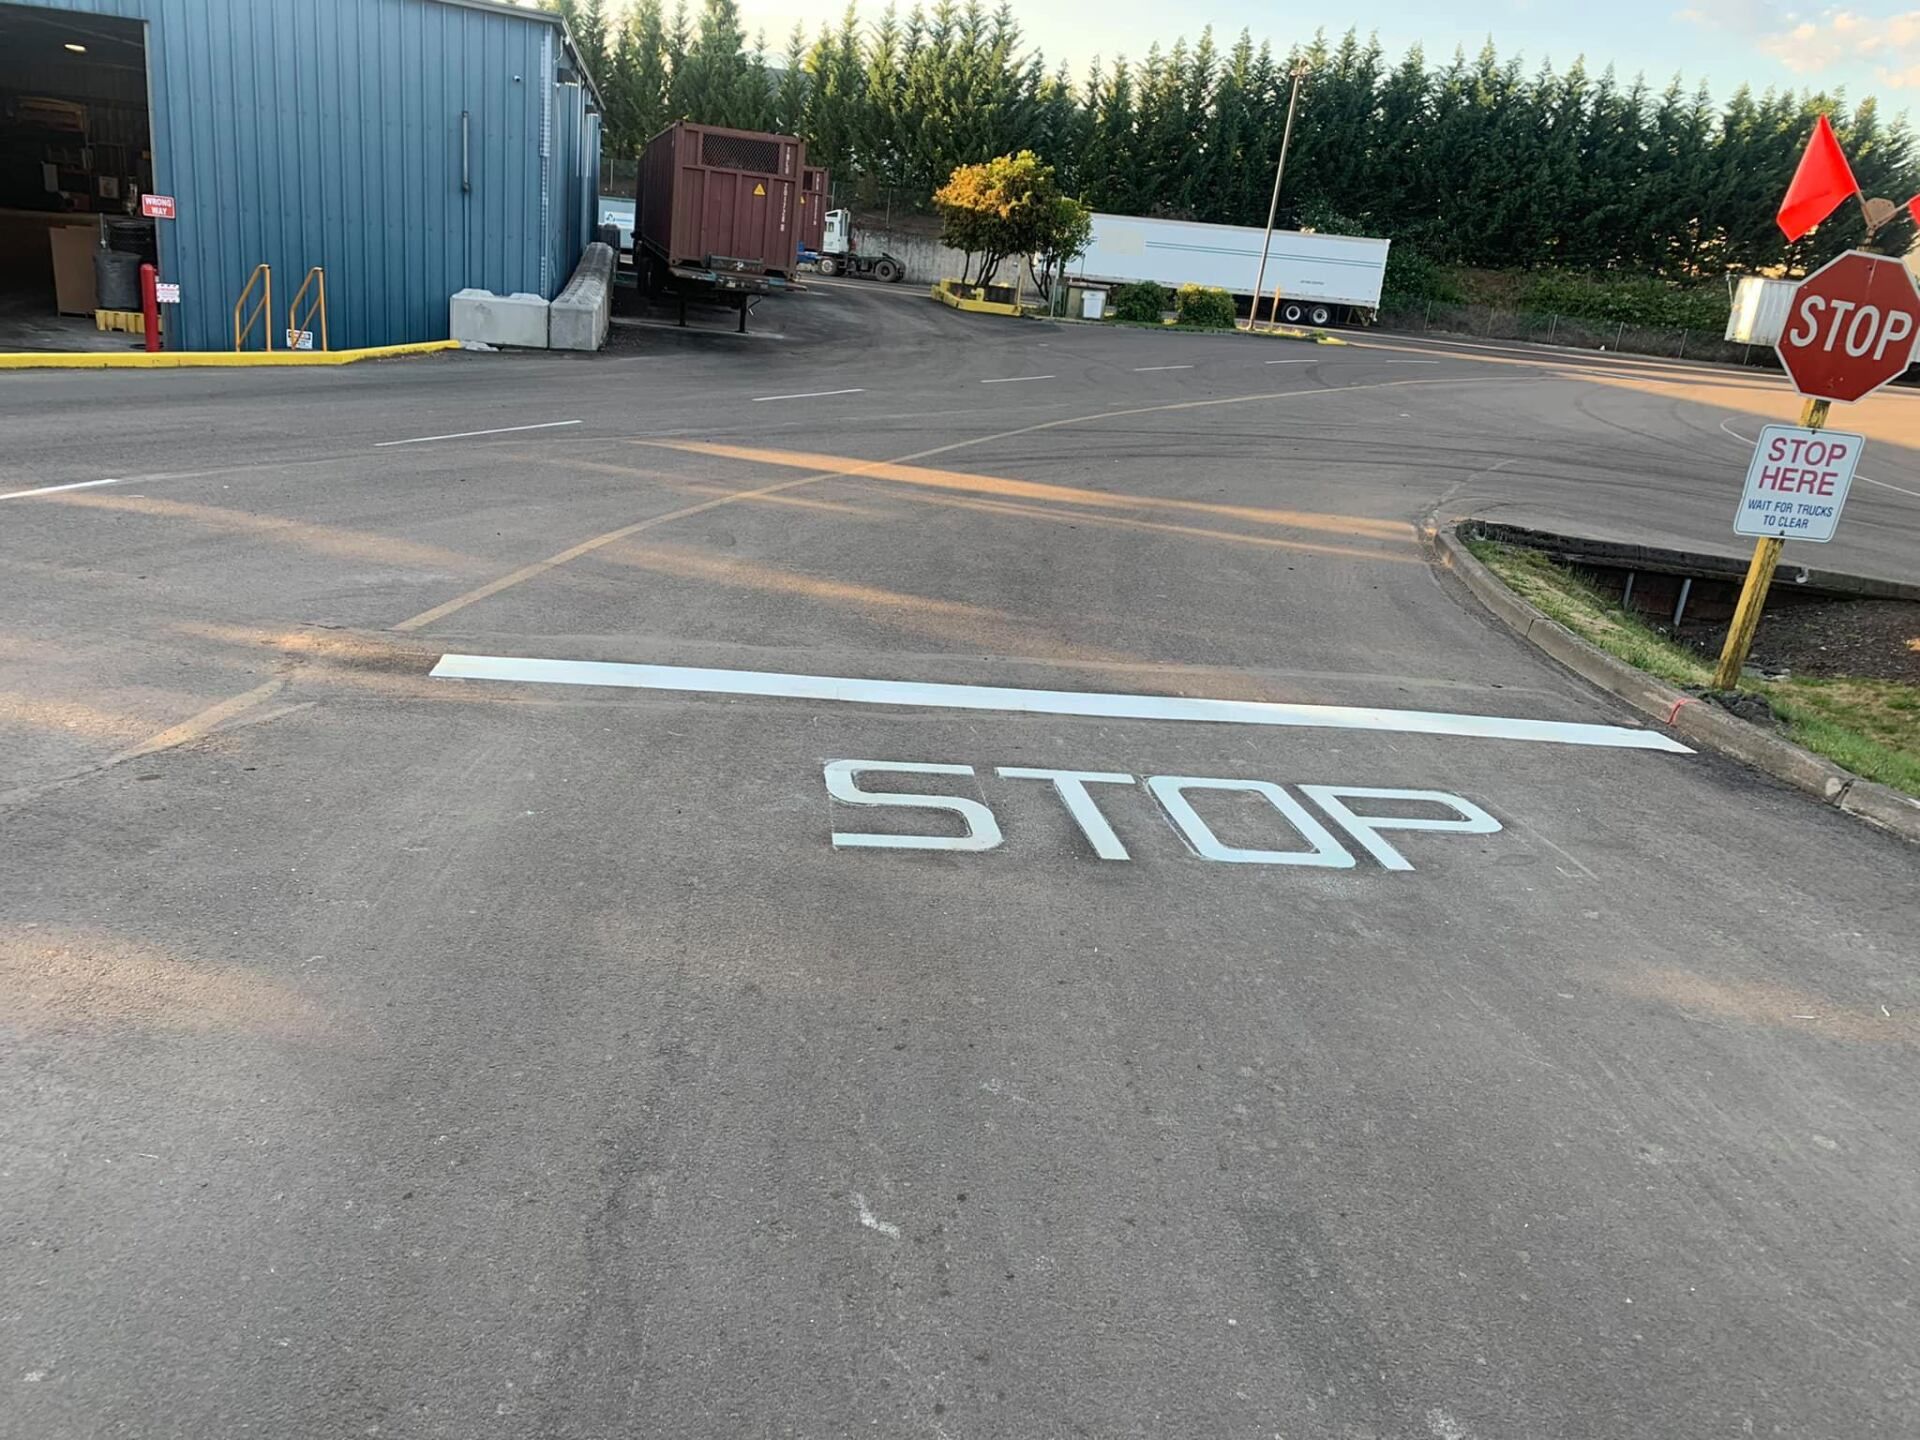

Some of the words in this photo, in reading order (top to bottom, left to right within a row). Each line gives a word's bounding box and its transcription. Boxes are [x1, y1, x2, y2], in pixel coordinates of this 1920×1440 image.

[145, 197, 172, 208] WRONG
[150, 206, 169, 216] WAY
[1789, 295, 1913, 361] STOP
[1768, 437, 1847, 467] STOP
[1758, 465, 1839, 496] HERE
[1748, 499, 1773, 510] WAIT
[1774, 501, 1793, 513] FOR
[1797, 503, 1834, 517] TRUCKS
[1763, 514, 1776, 526] TO
[1778, 516, 1809, 529] CLEAR
[824, 759, 1503, 871] STOP
